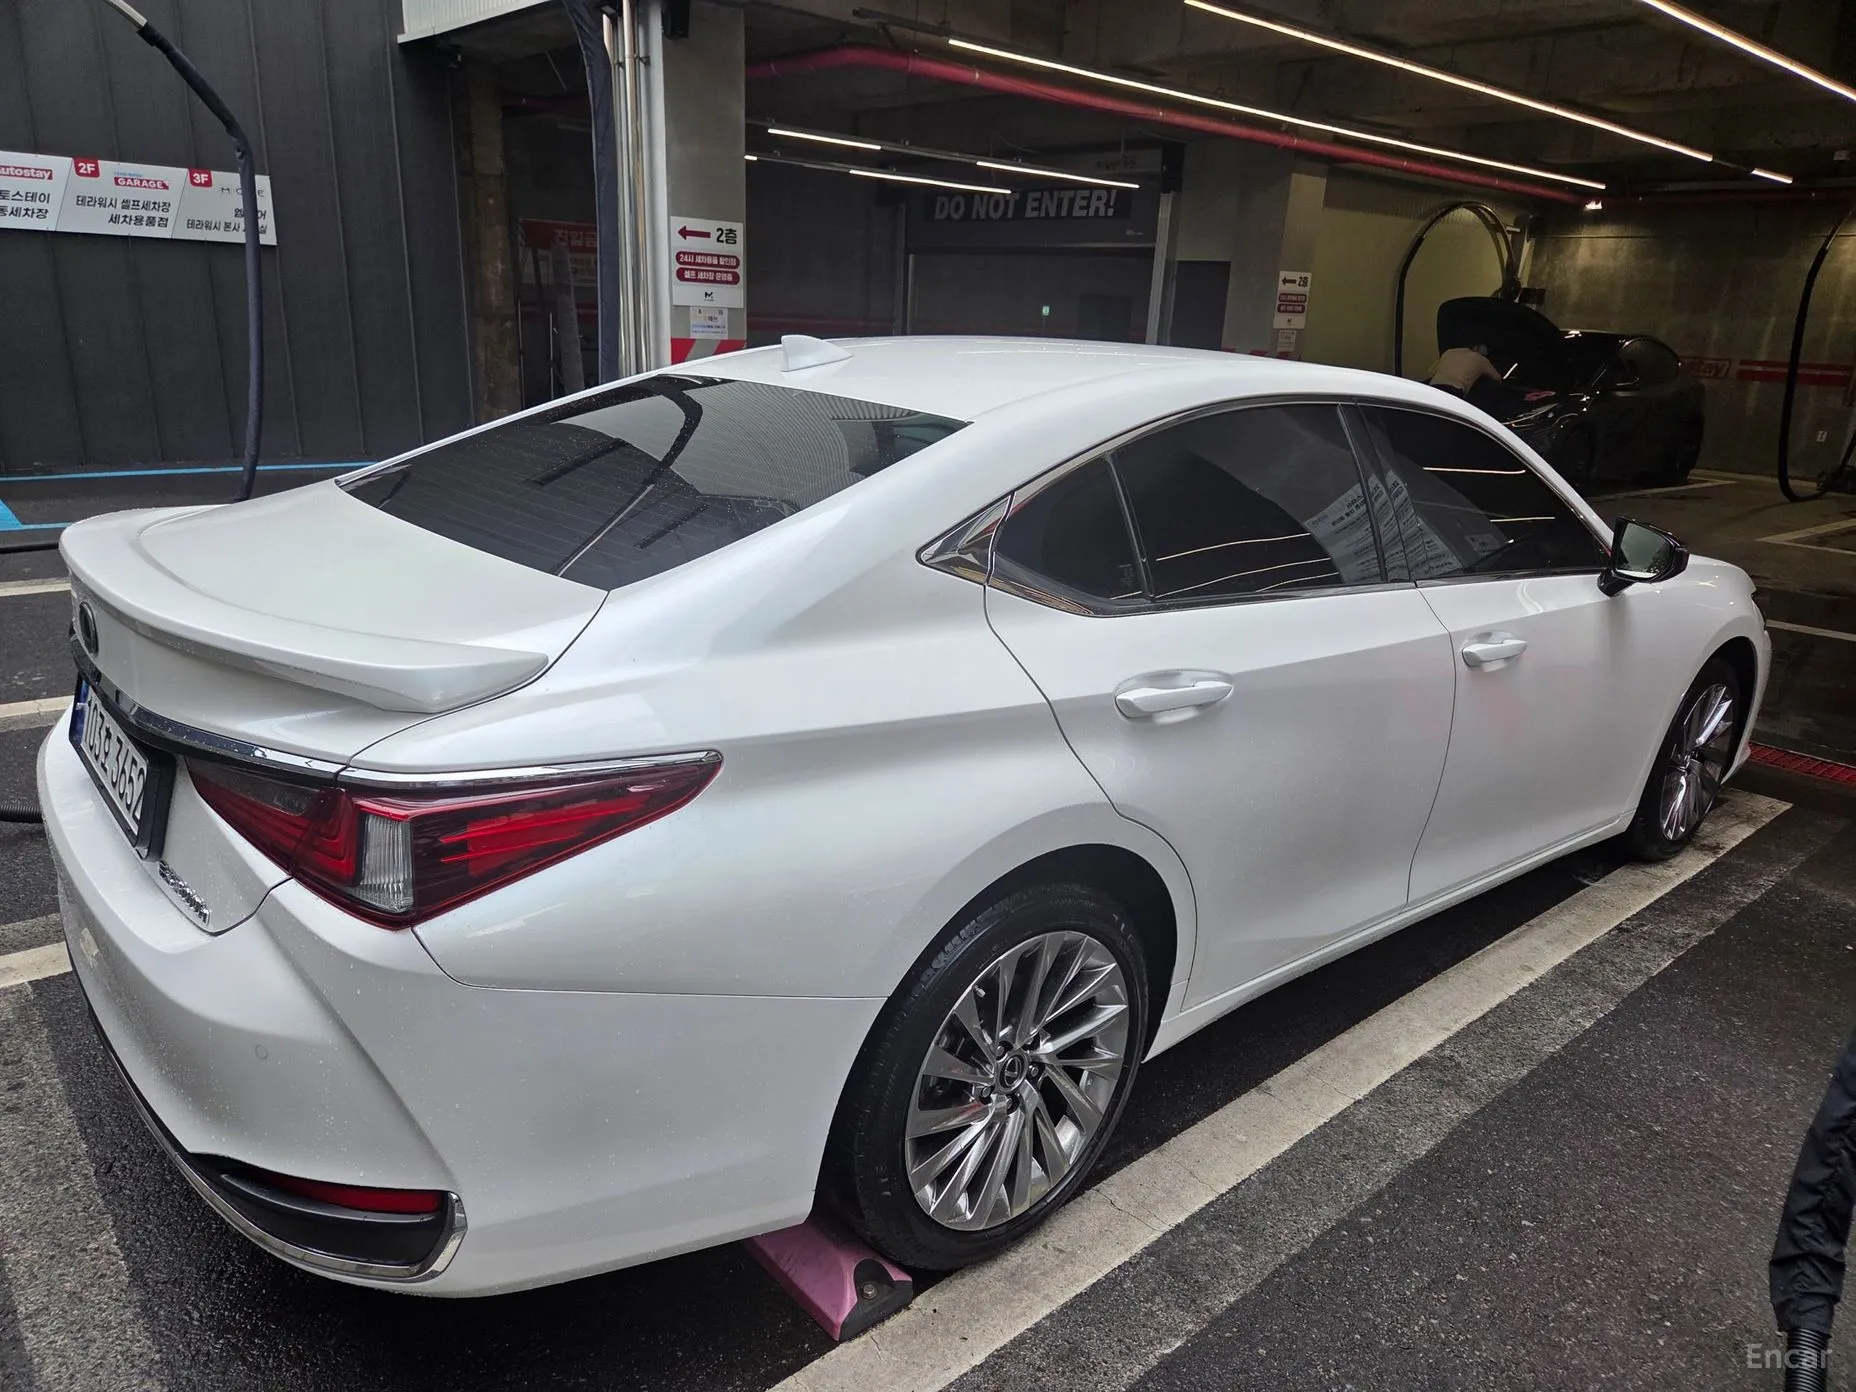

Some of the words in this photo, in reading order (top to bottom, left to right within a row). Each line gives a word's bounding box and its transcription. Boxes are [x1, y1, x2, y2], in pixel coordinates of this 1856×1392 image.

[0, 165, 51, 180] utostay
[78, 163, 95, 174] 2F
[117, 177, 164, 189] GARAGE
[193, 173, 208, 184] 3F
[76, 195, 118, 210] 테라워시
[121, 199, 171, 213] 셀프세차장
[934, 195, 965, 220] DO
[971, 193, 1020, 219] NOT
[1024, 189, 1118, 218] ENTER!
[108, 213, 169, 228] 세차용품점
[186, 218, 221, 231] 테라워시
[223, 221, 241, 233] 본사
[716, 227, 737, 245] 2층
[111, 735, 147, 827] 3652
